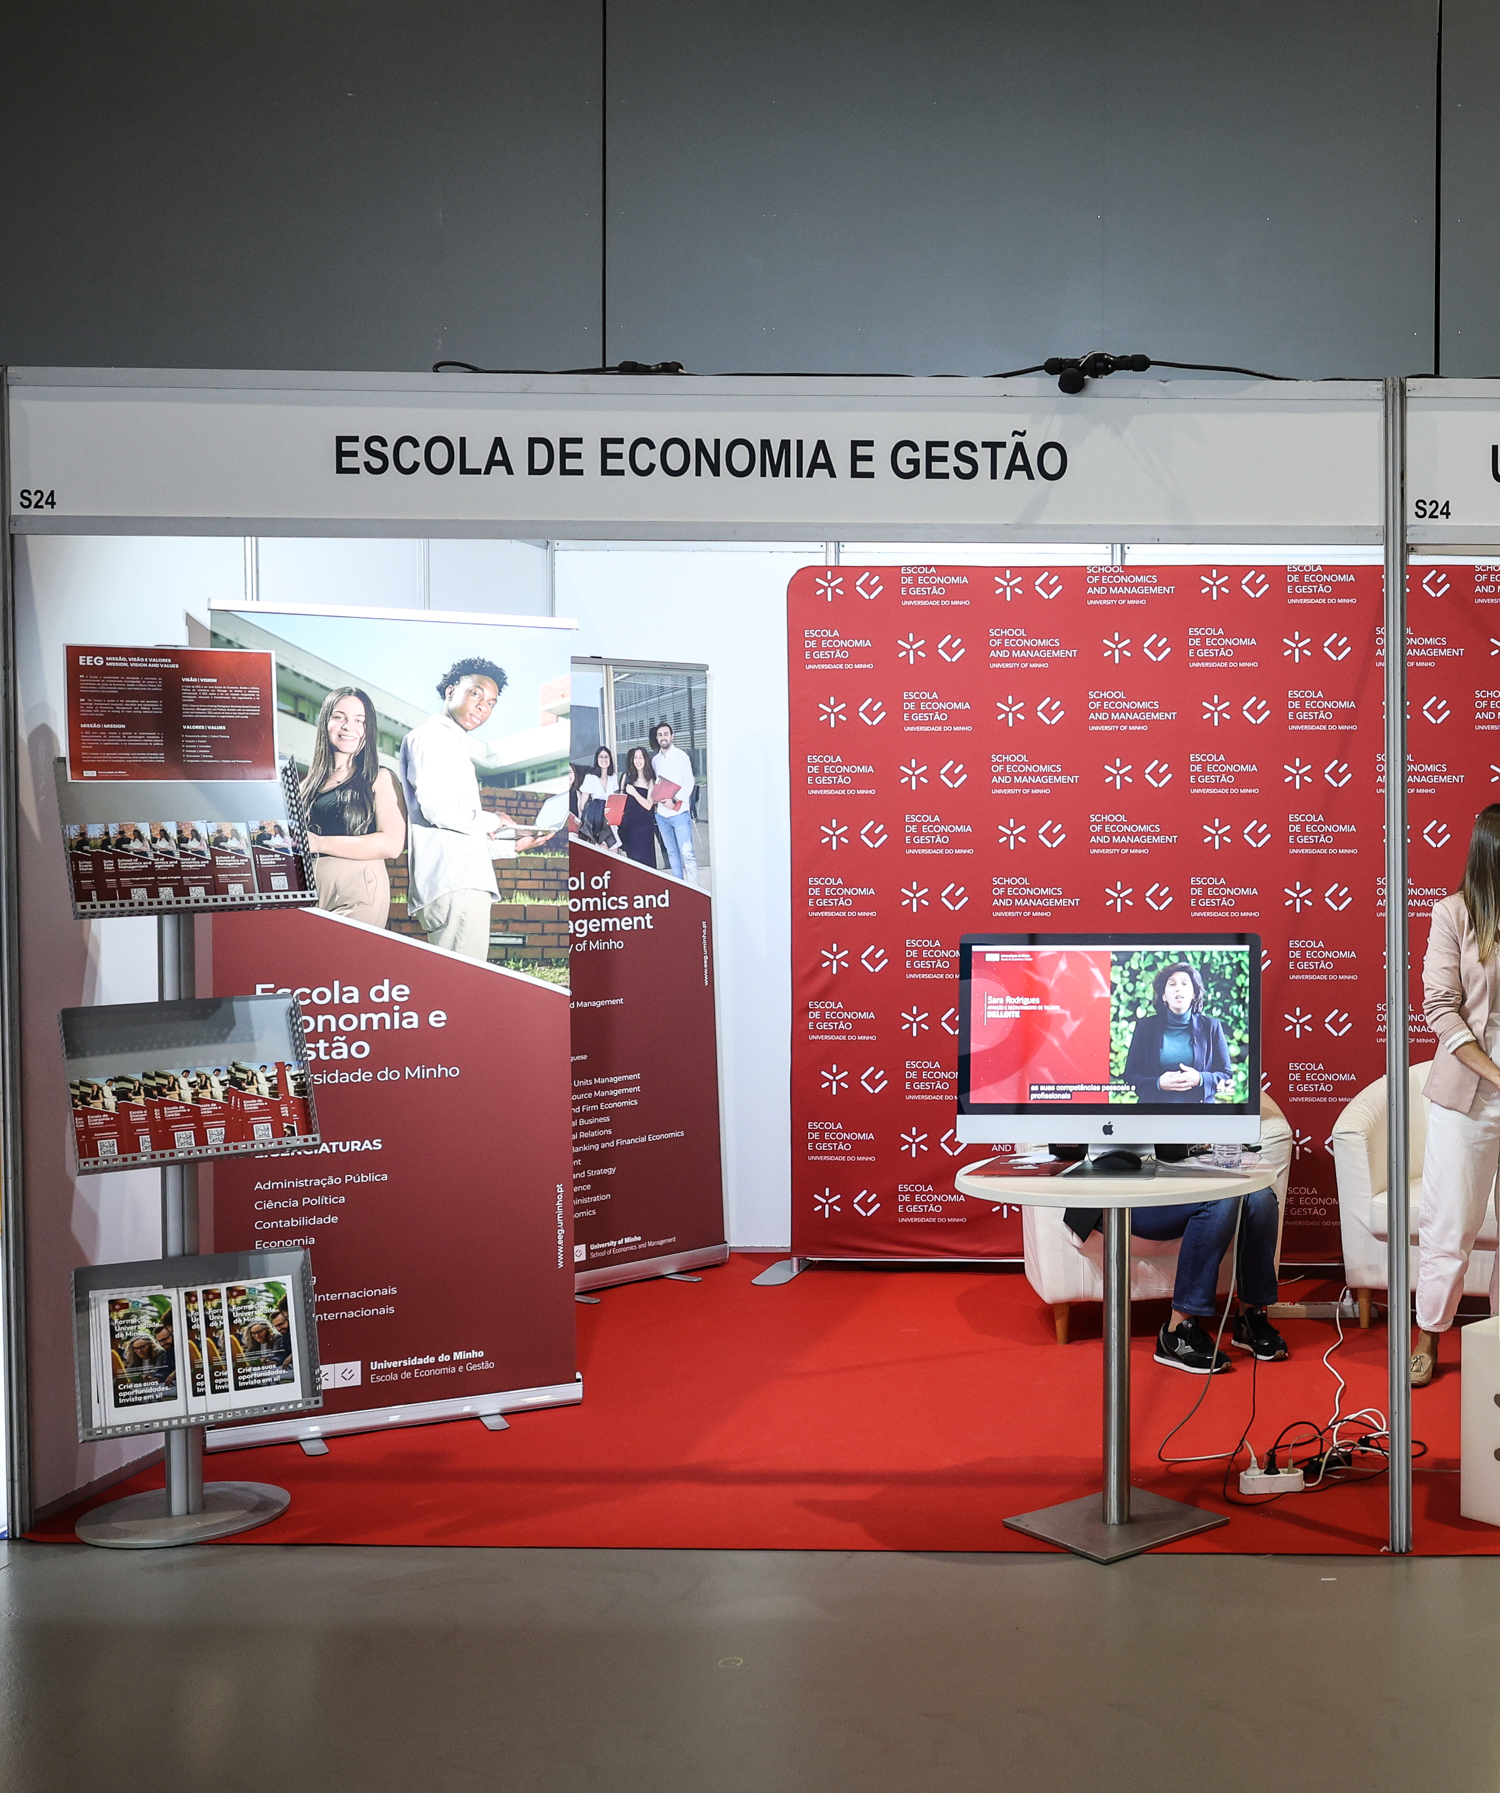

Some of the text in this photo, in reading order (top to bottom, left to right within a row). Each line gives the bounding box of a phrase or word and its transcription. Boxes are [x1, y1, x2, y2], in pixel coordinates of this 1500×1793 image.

[336, 430, 1067, 481] ESCOLA DE ECONOMIA E GESTÃO
[20, 489, 56, 509] S24
[1415, 499, 1451, 519] S24
[805, 629, 839, 637] ESCOLA
[805, 640, 817, 648] DE
[79, 656, 103, 665] EEG
[806, 649, 848, 659] E GESTÃO
[591, 871, 611, 889] of
[569, 890, 669, 913] omics and
[569, 913, 654, 938] agement
[576, 939, 623, 951] of Minho
[370, 979, 410, 1002] de
[577, 998, 623, 1008] Management
[809, 1001, 843, 1009] ESCOLA
[988, 996, 1040, 1005] Sara Rodrigues
[304, 1005, 447, 1033] onomia e
[809, 1011, 820, 1019] DE
[816, 1021, 852, 1030] GESTÃO
[306, 1036, 371, 1060] stão
[377, 1064, 459, 1081] do Minho
[594, 1073, 640, 1084] Management
[594, 1086, 640, 1097] Management
[600, 1100, 638, 1109] Economics
[579, 1116, 610, 1125] Business
[580, 1129, 612, 1138] Relations
[601, 1140, 614, 1148] and
[616, 1135, 646, 1146] Financial
[648, 1131, 684, 1141] Economics
[587, 1167, 616, 1177] Strategy
[254, 1173, 387, 1190] Administração Pública
[255, 1195, 345, 1210] Ciência Política
[255, 1215, 338, 1229] Contabilidade
[556, 1183, 564, 1269] www.eeg.uminho.pt
[256, 1236, 315, 1249] Economia
[315, 1287, 397, 1302] Internacionais
[315, 1304, 395, 1322] nternacionais
[371, 1350, 484, 1370] Universidade do Minho
[371, 1372, 398, 1383] Escola
[401, 1371, 411, 1379] de
[415, 1367, 455, 1377] Economia
[466, 1361, 494, 1371] Gestão
